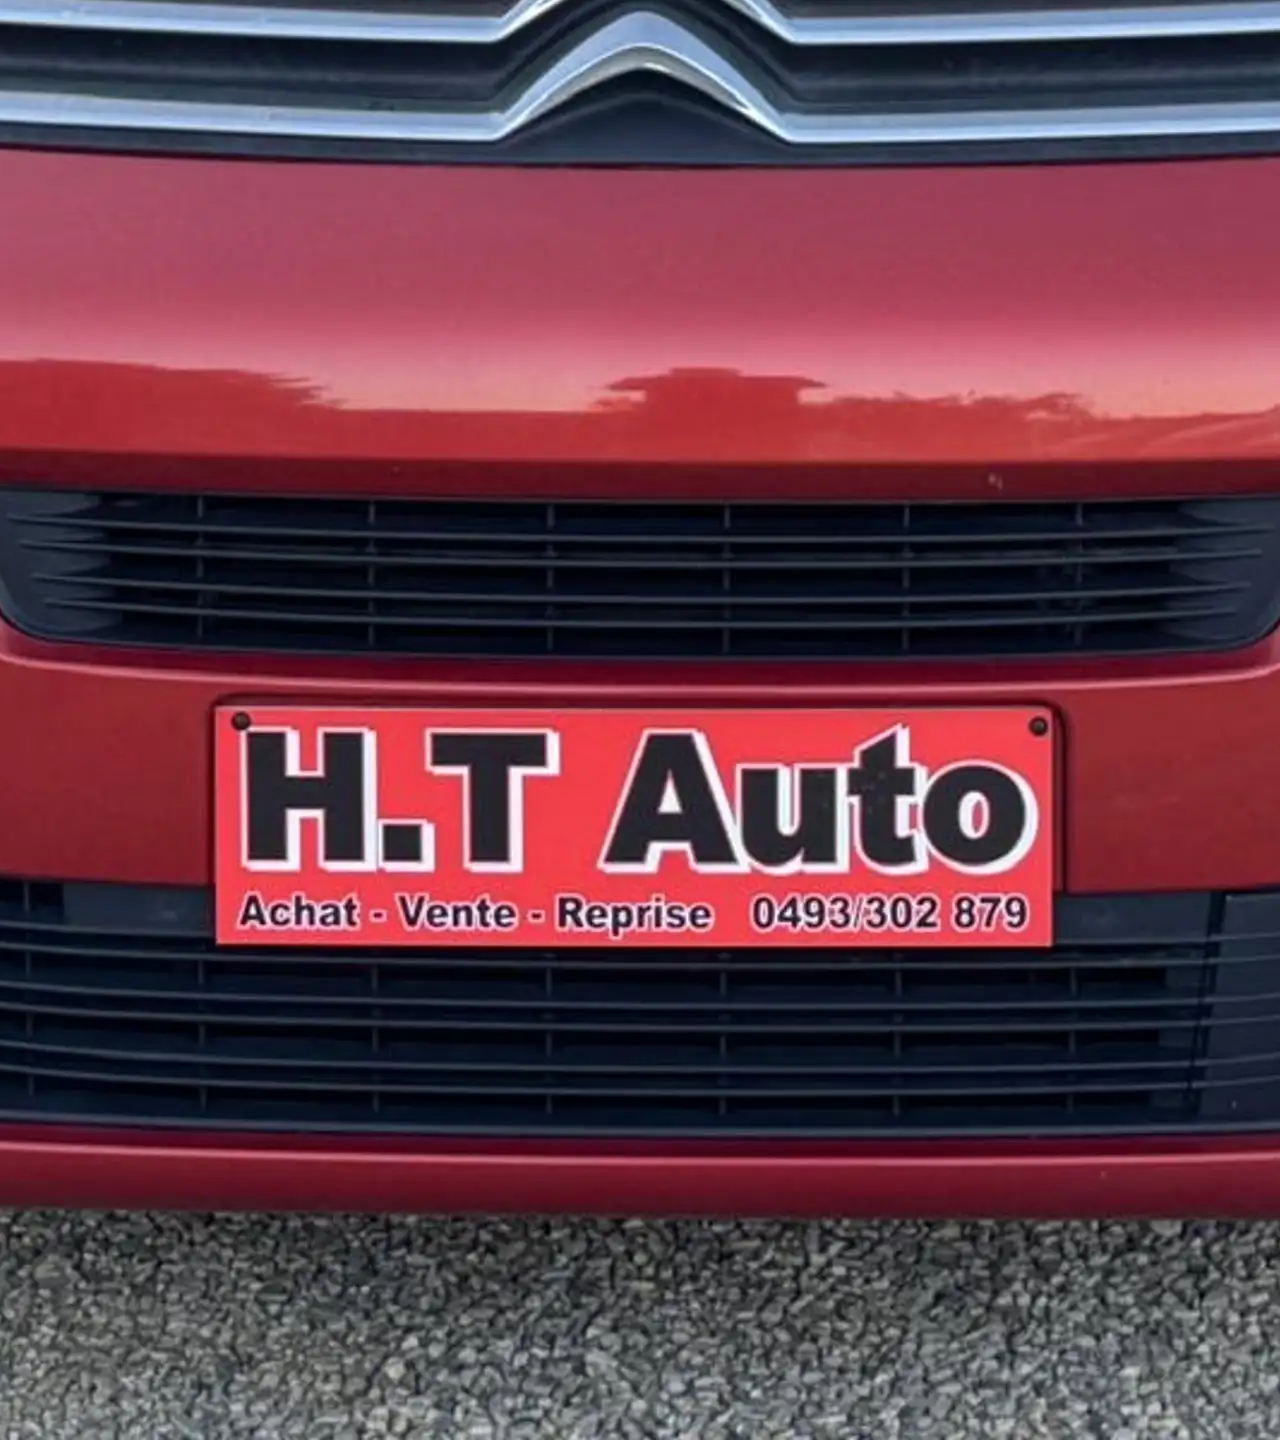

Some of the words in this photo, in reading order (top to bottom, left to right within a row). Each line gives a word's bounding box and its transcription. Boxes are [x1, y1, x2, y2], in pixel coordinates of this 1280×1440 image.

[240, 726, 560, 872] H.T
[597, 724, 1039, 876] Auto
[238, 894, 360, 931] Achat
[397, 895, 516, 931] Vente
[556, 895, 713, 938] Reprise
[752, 893, 940, 932] 0493/302
[951, 893, 1029, 932] 879
